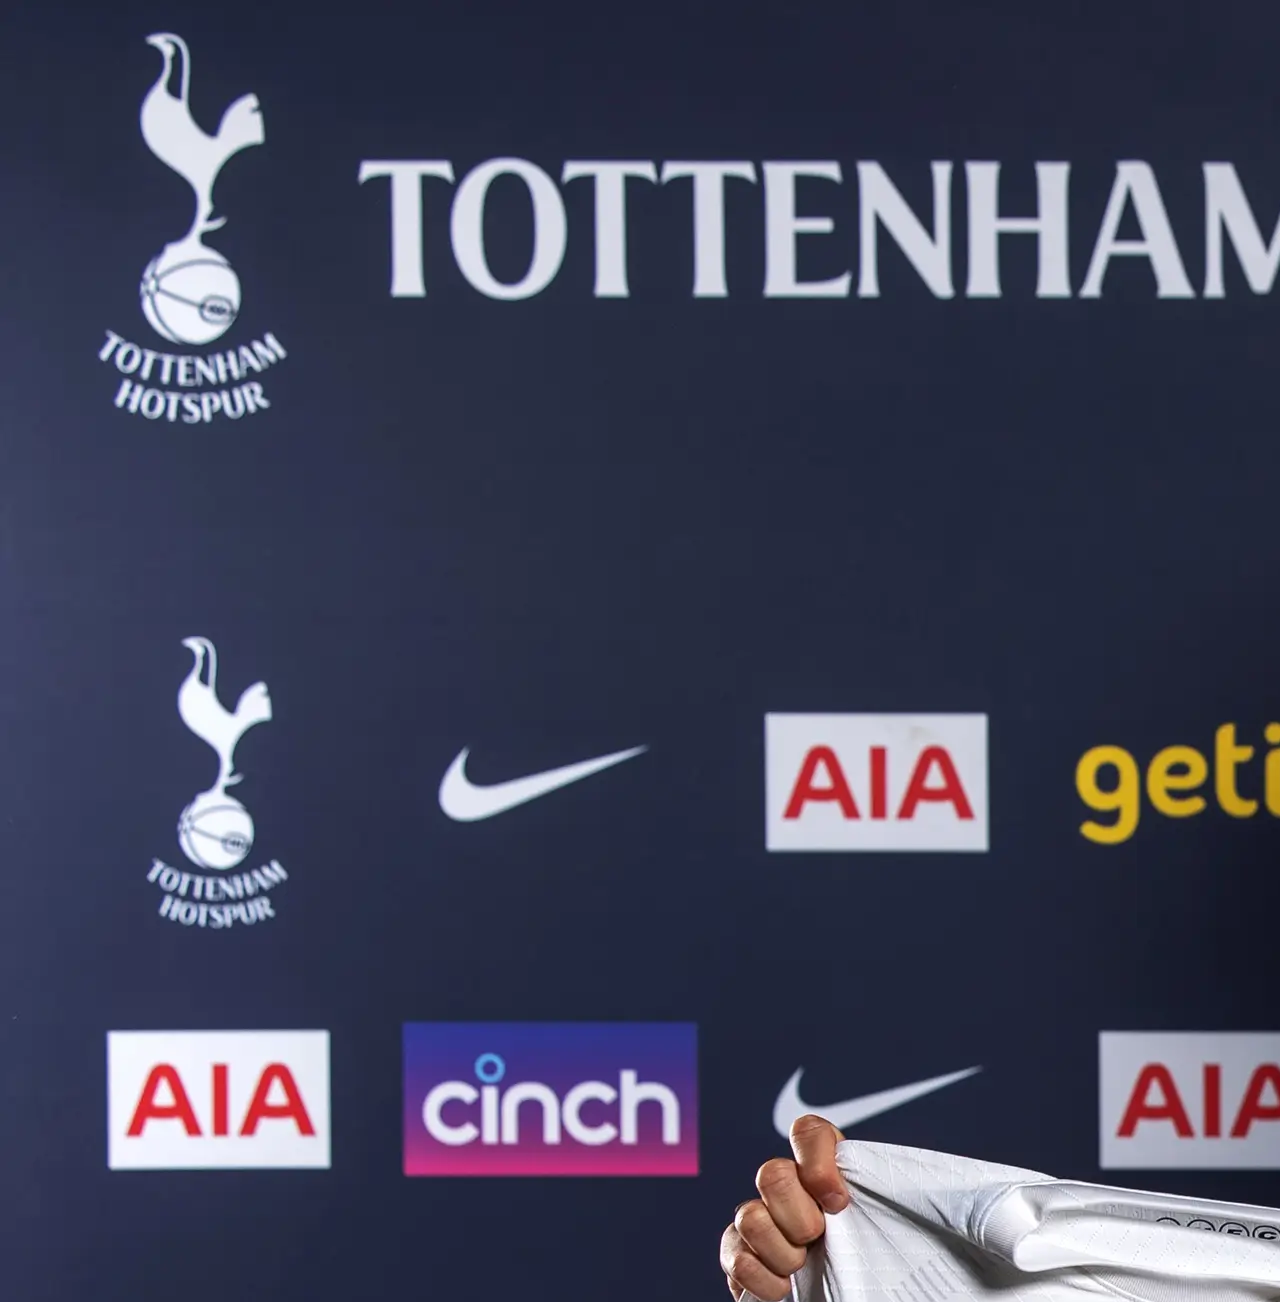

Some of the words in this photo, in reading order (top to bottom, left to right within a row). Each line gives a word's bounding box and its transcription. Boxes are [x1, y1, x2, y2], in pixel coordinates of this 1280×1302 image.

[99, 330, 288, 387] TOTTENHAM
[114, 378, 271, 424] HOTSPUR
[783, 744, 974, 821] AIA
[147, 858, 288, 902] TOTTENHAM
[159, 894, 275, 929] HOTSPUR
[126, 1062, 315, 1138] AIA
[420, 1051, 682, 1148] cinch
